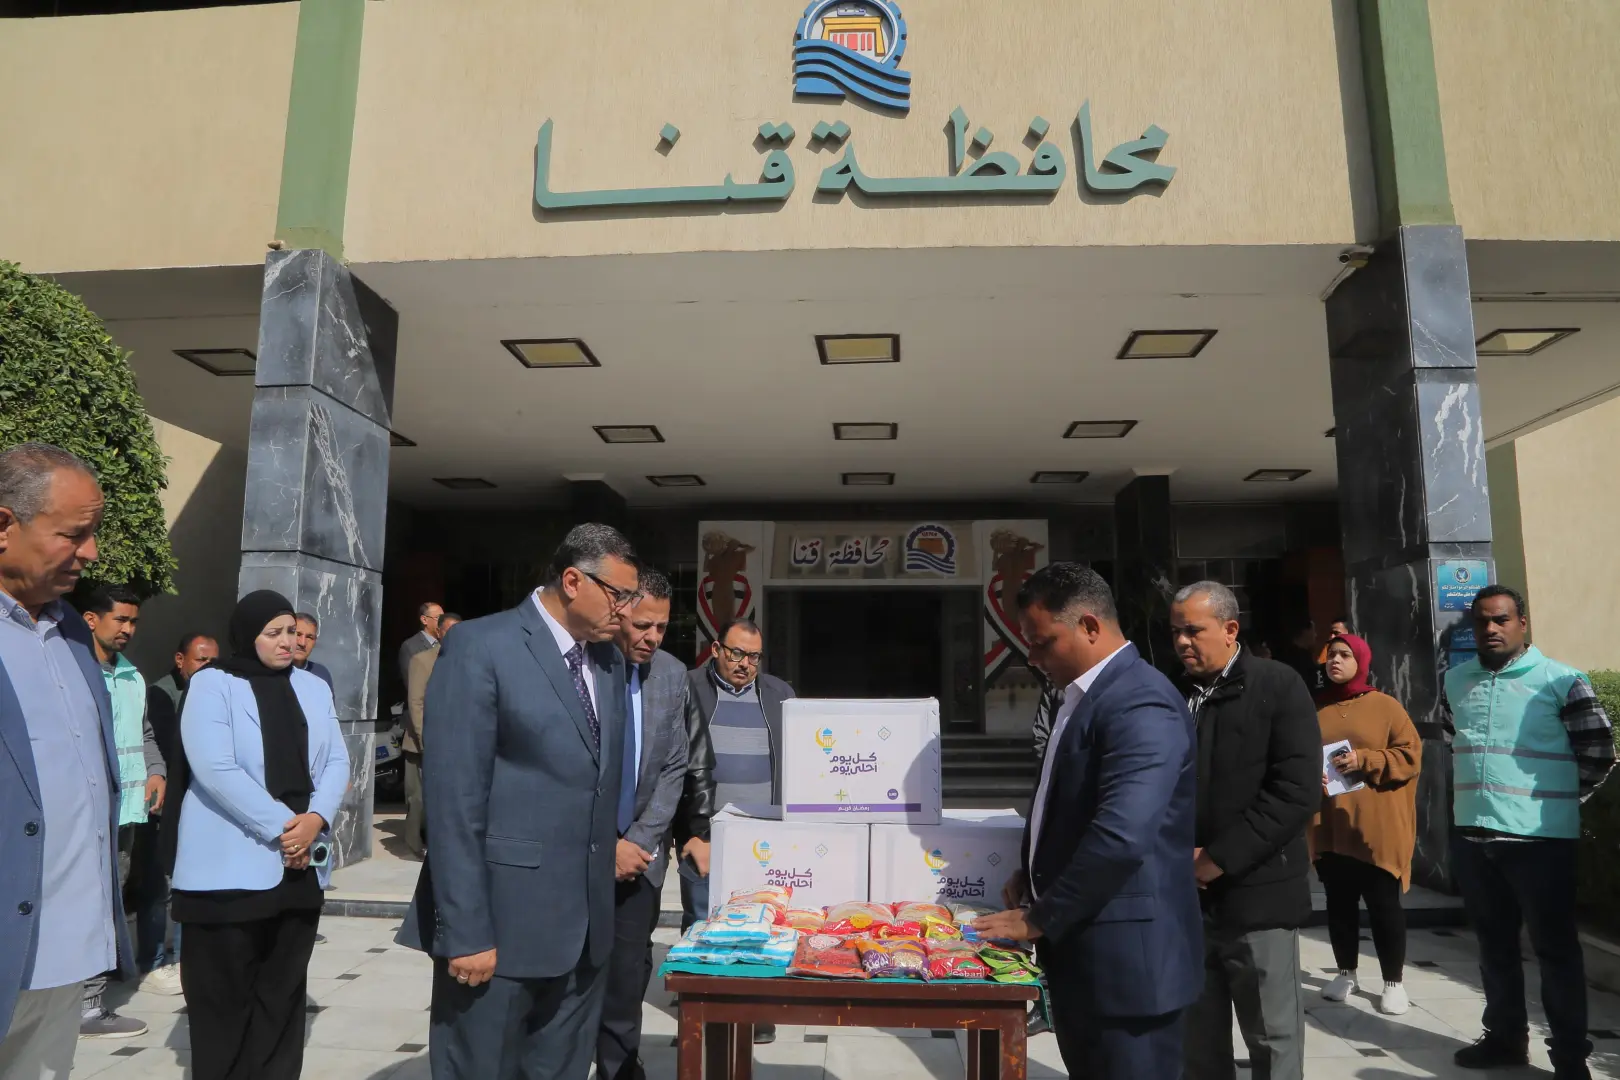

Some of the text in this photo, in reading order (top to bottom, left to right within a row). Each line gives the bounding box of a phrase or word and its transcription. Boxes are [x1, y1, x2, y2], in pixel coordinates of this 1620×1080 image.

[535, 99, 1177, 209] محافظة قنا
[792, 537, 890, 568] محافظة قنا
[829, 752, 877, 765] كل يوم
[829, 766, 851, 775] يوم
[765, 868, 813, 879] كل يوم
[937, 876, 985, 888] كل يوم
[936, 887, 957, 898] يوم
